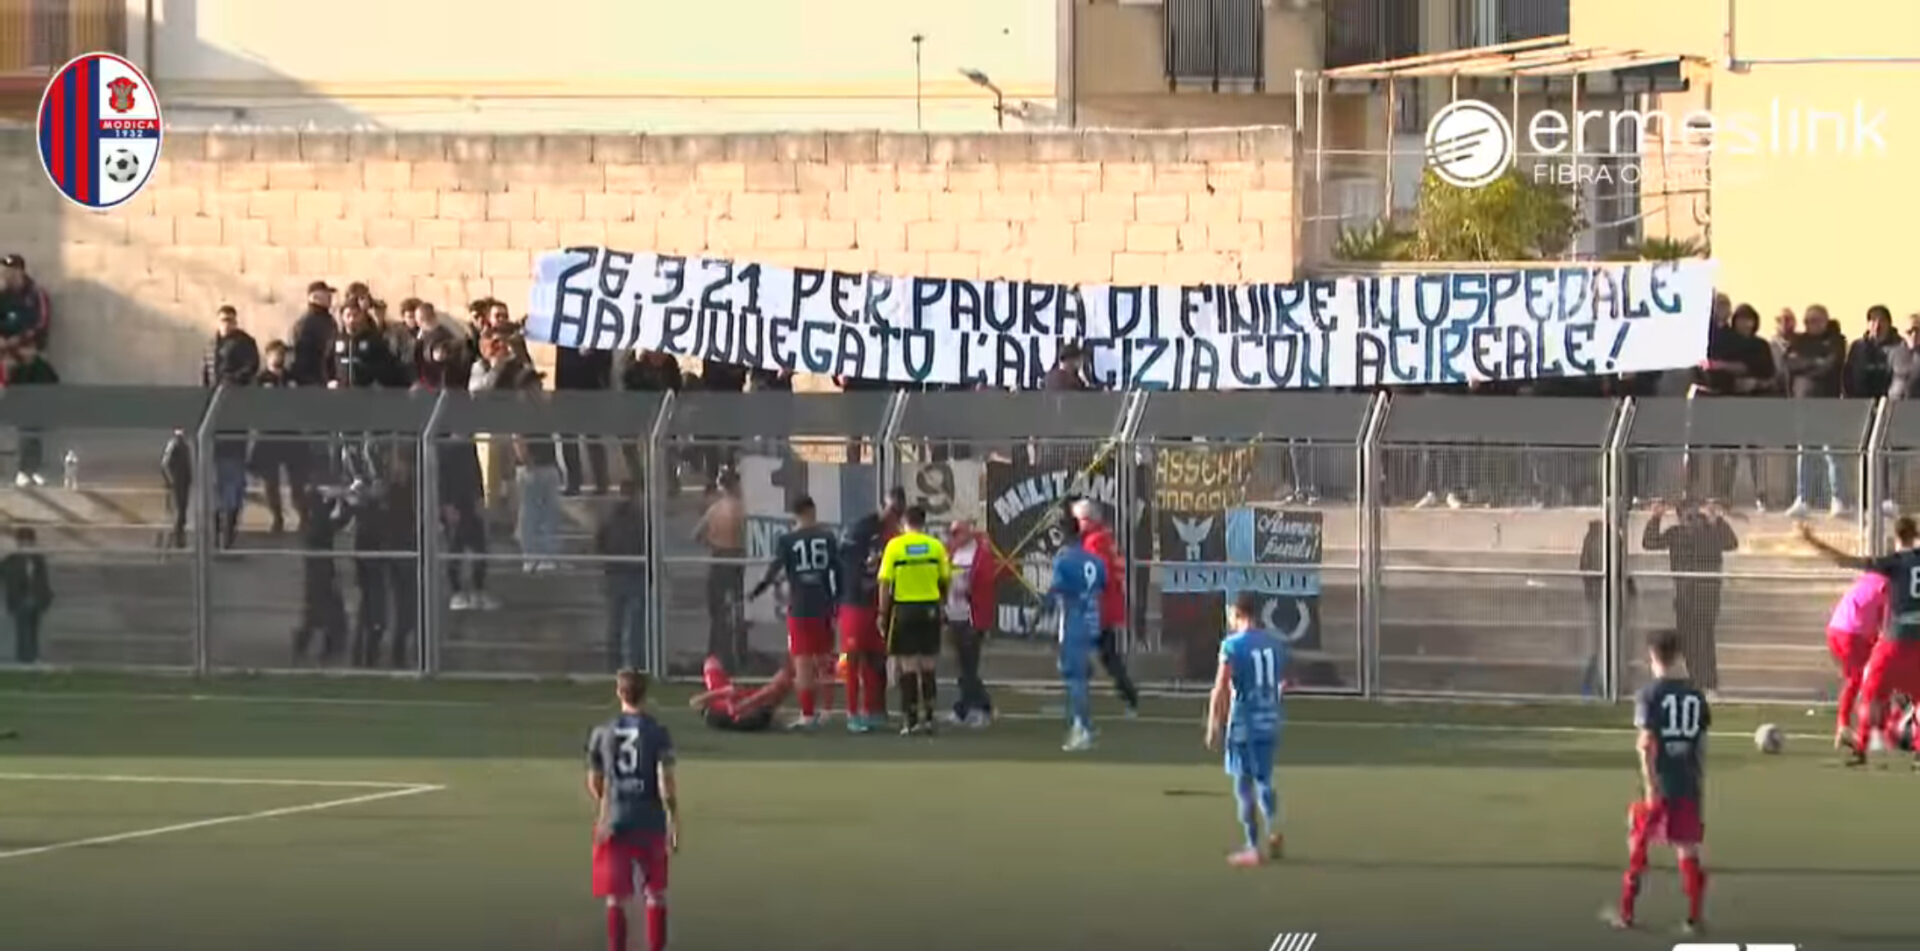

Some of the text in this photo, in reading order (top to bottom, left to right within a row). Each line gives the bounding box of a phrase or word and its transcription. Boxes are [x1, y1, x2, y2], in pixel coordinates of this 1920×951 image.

[789, 267, 892, 331] PER
[913, 276, 1086, 337] PAURA
[1109, 284, 1158, 338] DI
[1181, 281, 1338, 337] FINIRE
[1357, 277, 1400, 328] IN
[1414, 261, 1682, 328] OSPEDALE
[657, 306, 935, 382] RINNEGATO
[959, 331, 1220, 391] L'AMCIZIA
[1231, 332, 1331, 388] CON
[1356, 320, 1631, 387] ACIREALE!
[792, 538, 829, 572] 16
[1083, 560, 1097, 592] 9
[1251, 647, 1275, 688] 11
[1661, 693, 1701, 738] 10
[614, 727, 640, 774] 3
